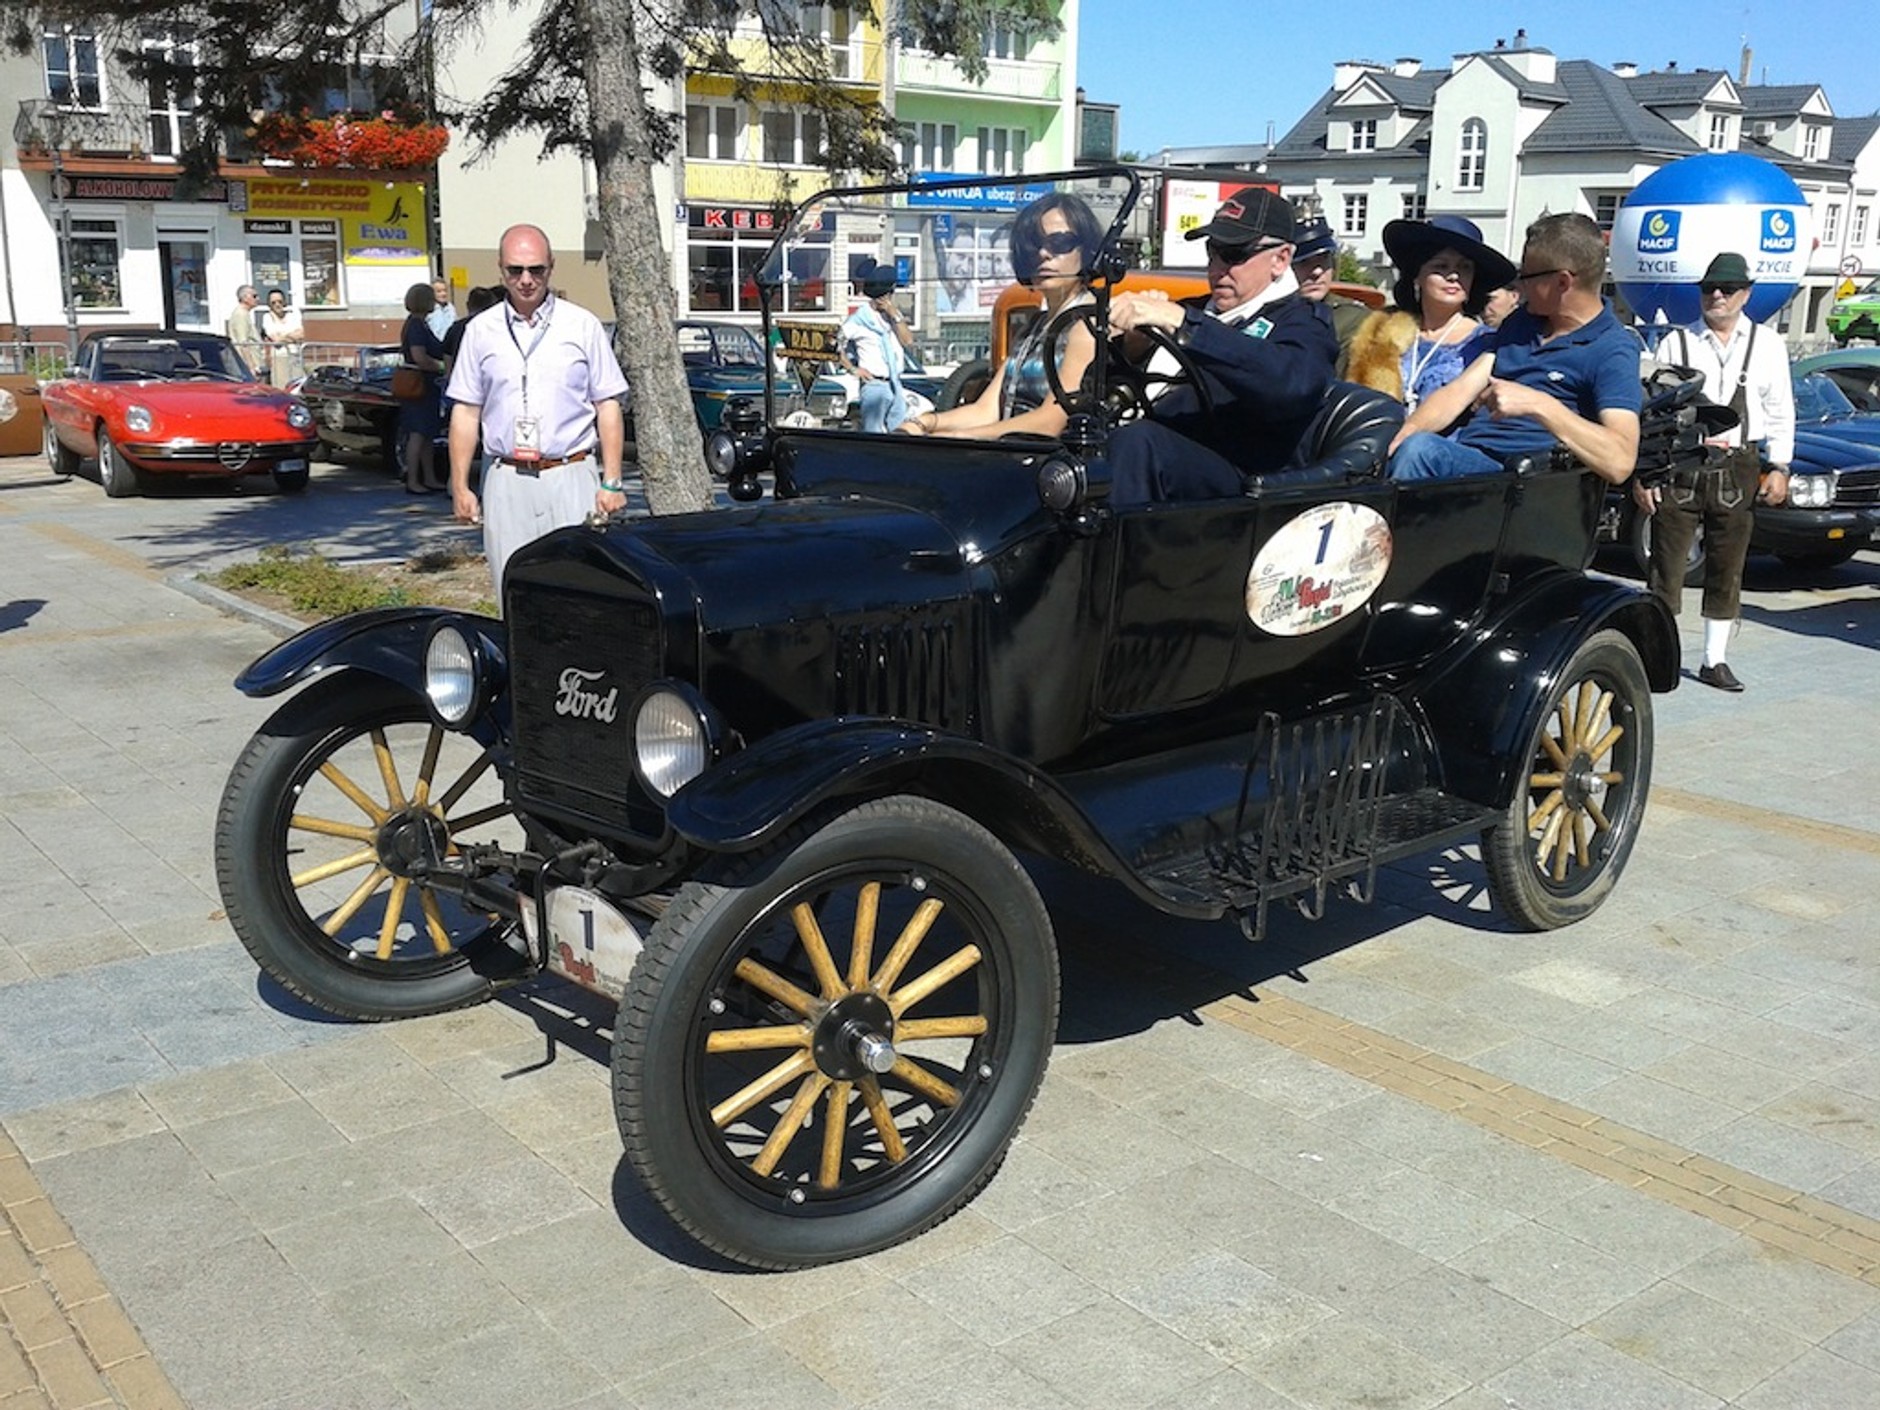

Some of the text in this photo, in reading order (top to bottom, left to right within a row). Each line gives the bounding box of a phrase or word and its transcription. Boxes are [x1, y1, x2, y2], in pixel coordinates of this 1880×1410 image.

[360, 224, 407, 240] Ewa
[1640, 238, 1675, 249] MACIF
[1762, 238, 1795, 249] MACIF
[1315, 519, 1334, 565] 1
[555, 668, 619, 723] Ford
[579, 910, 594, 951] 1
